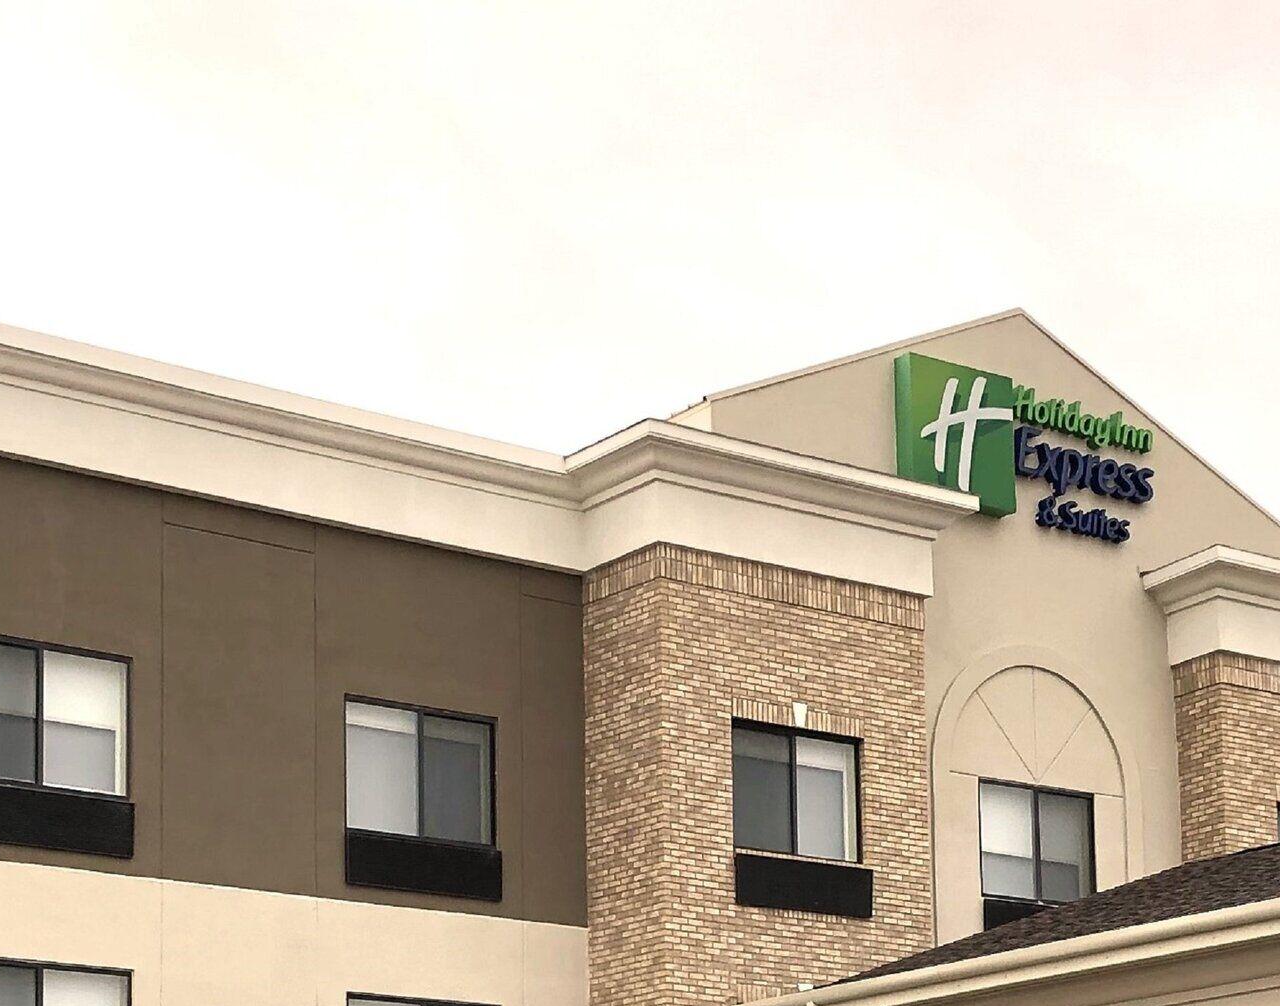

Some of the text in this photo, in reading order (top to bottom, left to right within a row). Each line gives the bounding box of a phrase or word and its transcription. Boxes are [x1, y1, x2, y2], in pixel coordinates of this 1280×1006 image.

[1013, 384, 1154, 454] Holiday Inn
[1015, 426, 1155, 503] Express
